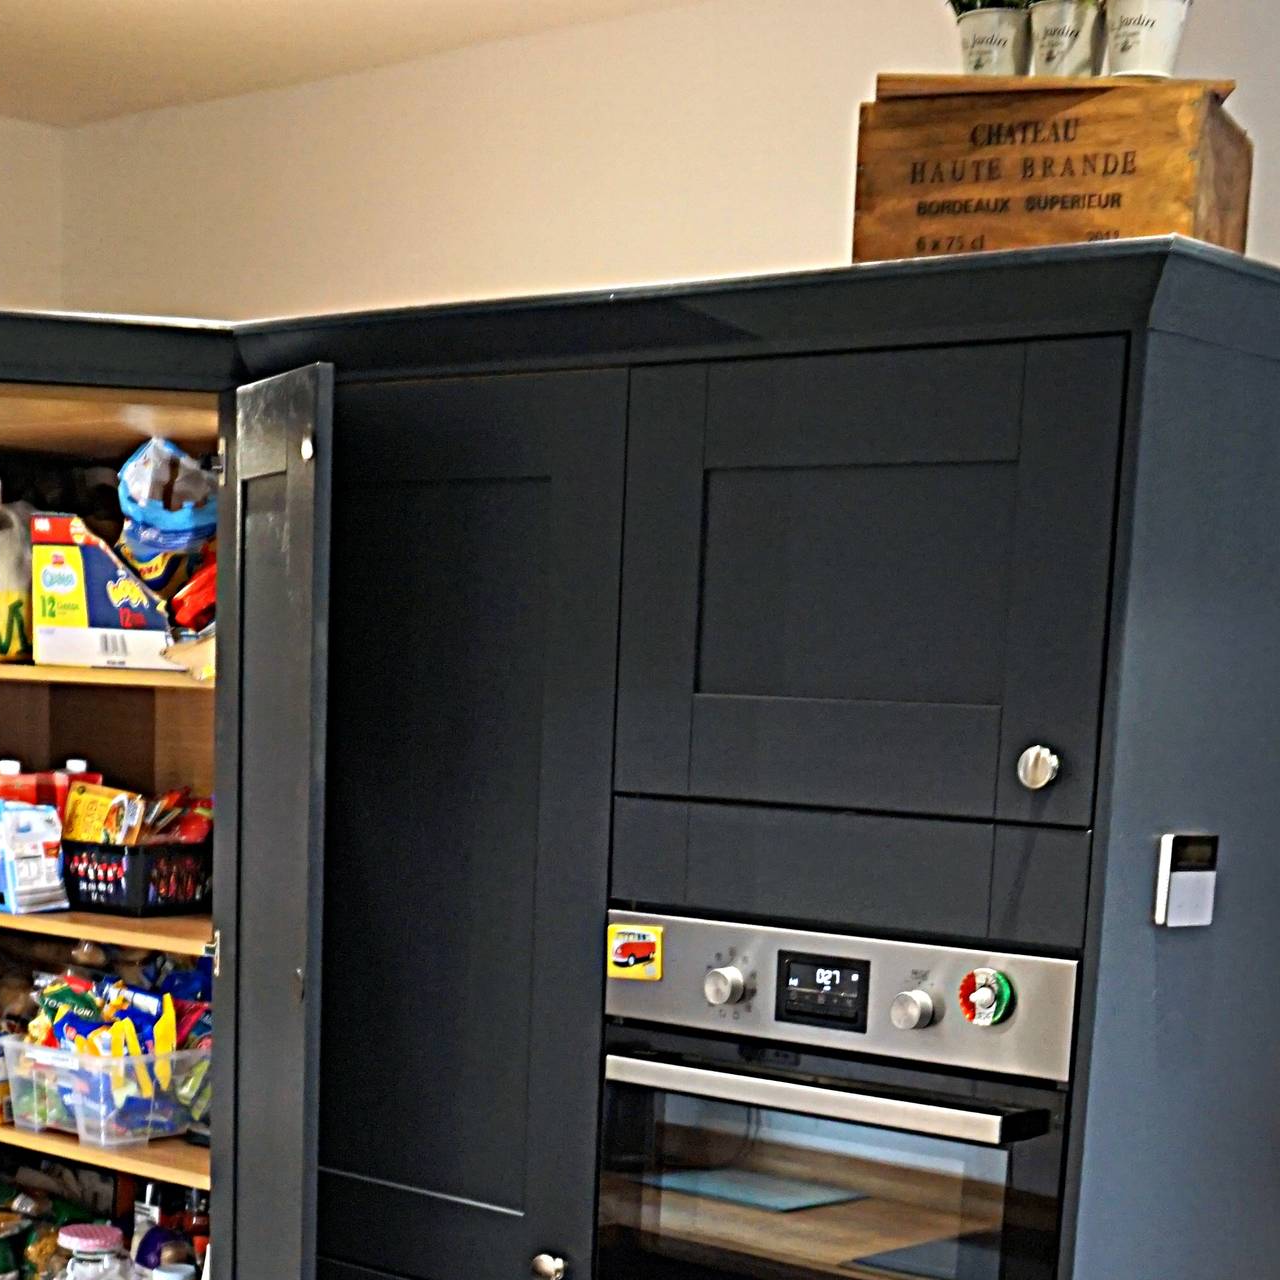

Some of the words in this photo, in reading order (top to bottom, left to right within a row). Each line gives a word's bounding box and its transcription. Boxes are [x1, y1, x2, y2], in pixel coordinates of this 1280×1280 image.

[971, 118, 1080, 146] CHATEAU
[910, 157, 1001, 184] HAUTE
[1022, 151, 1137, 179] BRANDE
[916, 197, 1010, 216] BORDEAUX
[1024, 193, 1122, 212] SUPERIEUR
